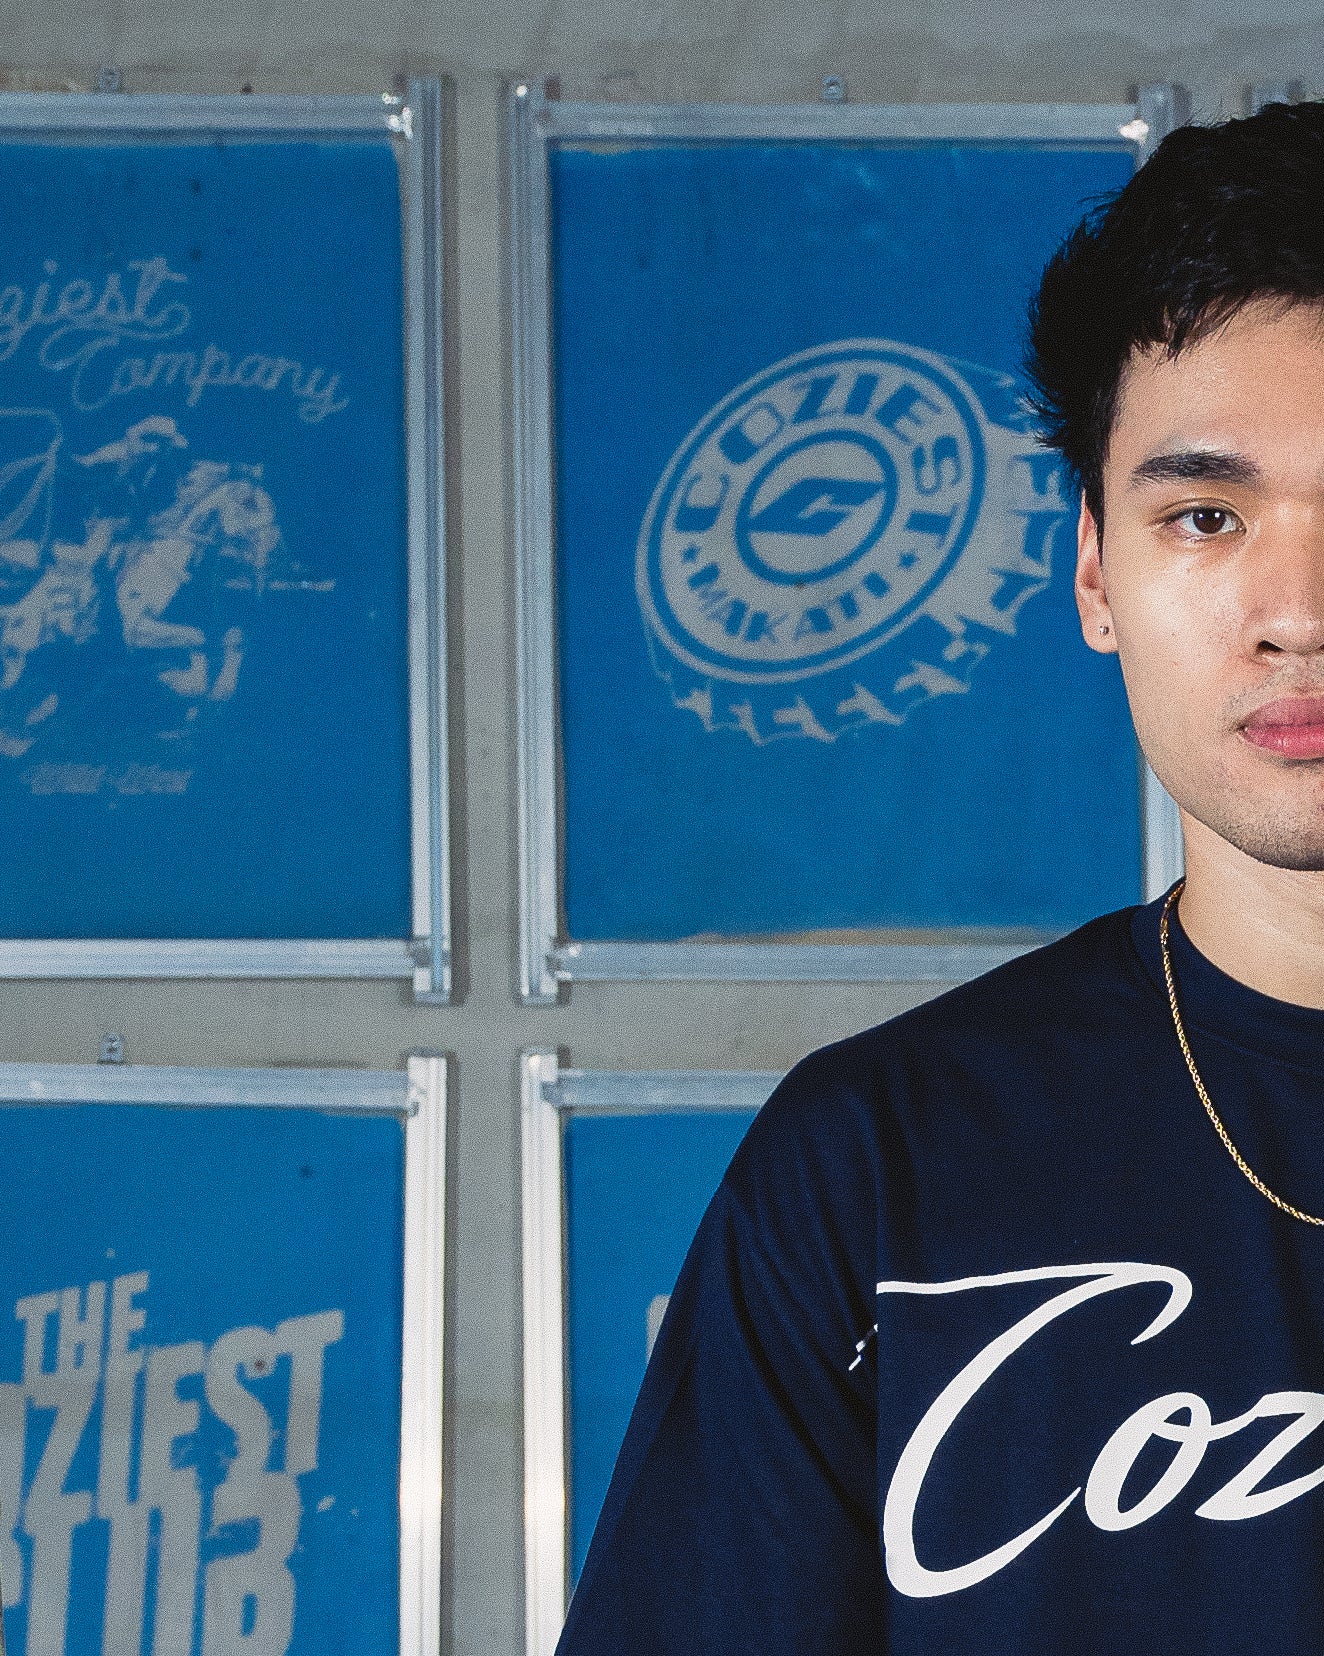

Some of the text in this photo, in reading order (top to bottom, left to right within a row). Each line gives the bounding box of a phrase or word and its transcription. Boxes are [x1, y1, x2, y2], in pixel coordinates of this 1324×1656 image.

[72, 338, 350, 424] Company
[672, 370, 964, 552] COZIEST
[15, 1270, 149, 1378] THE
